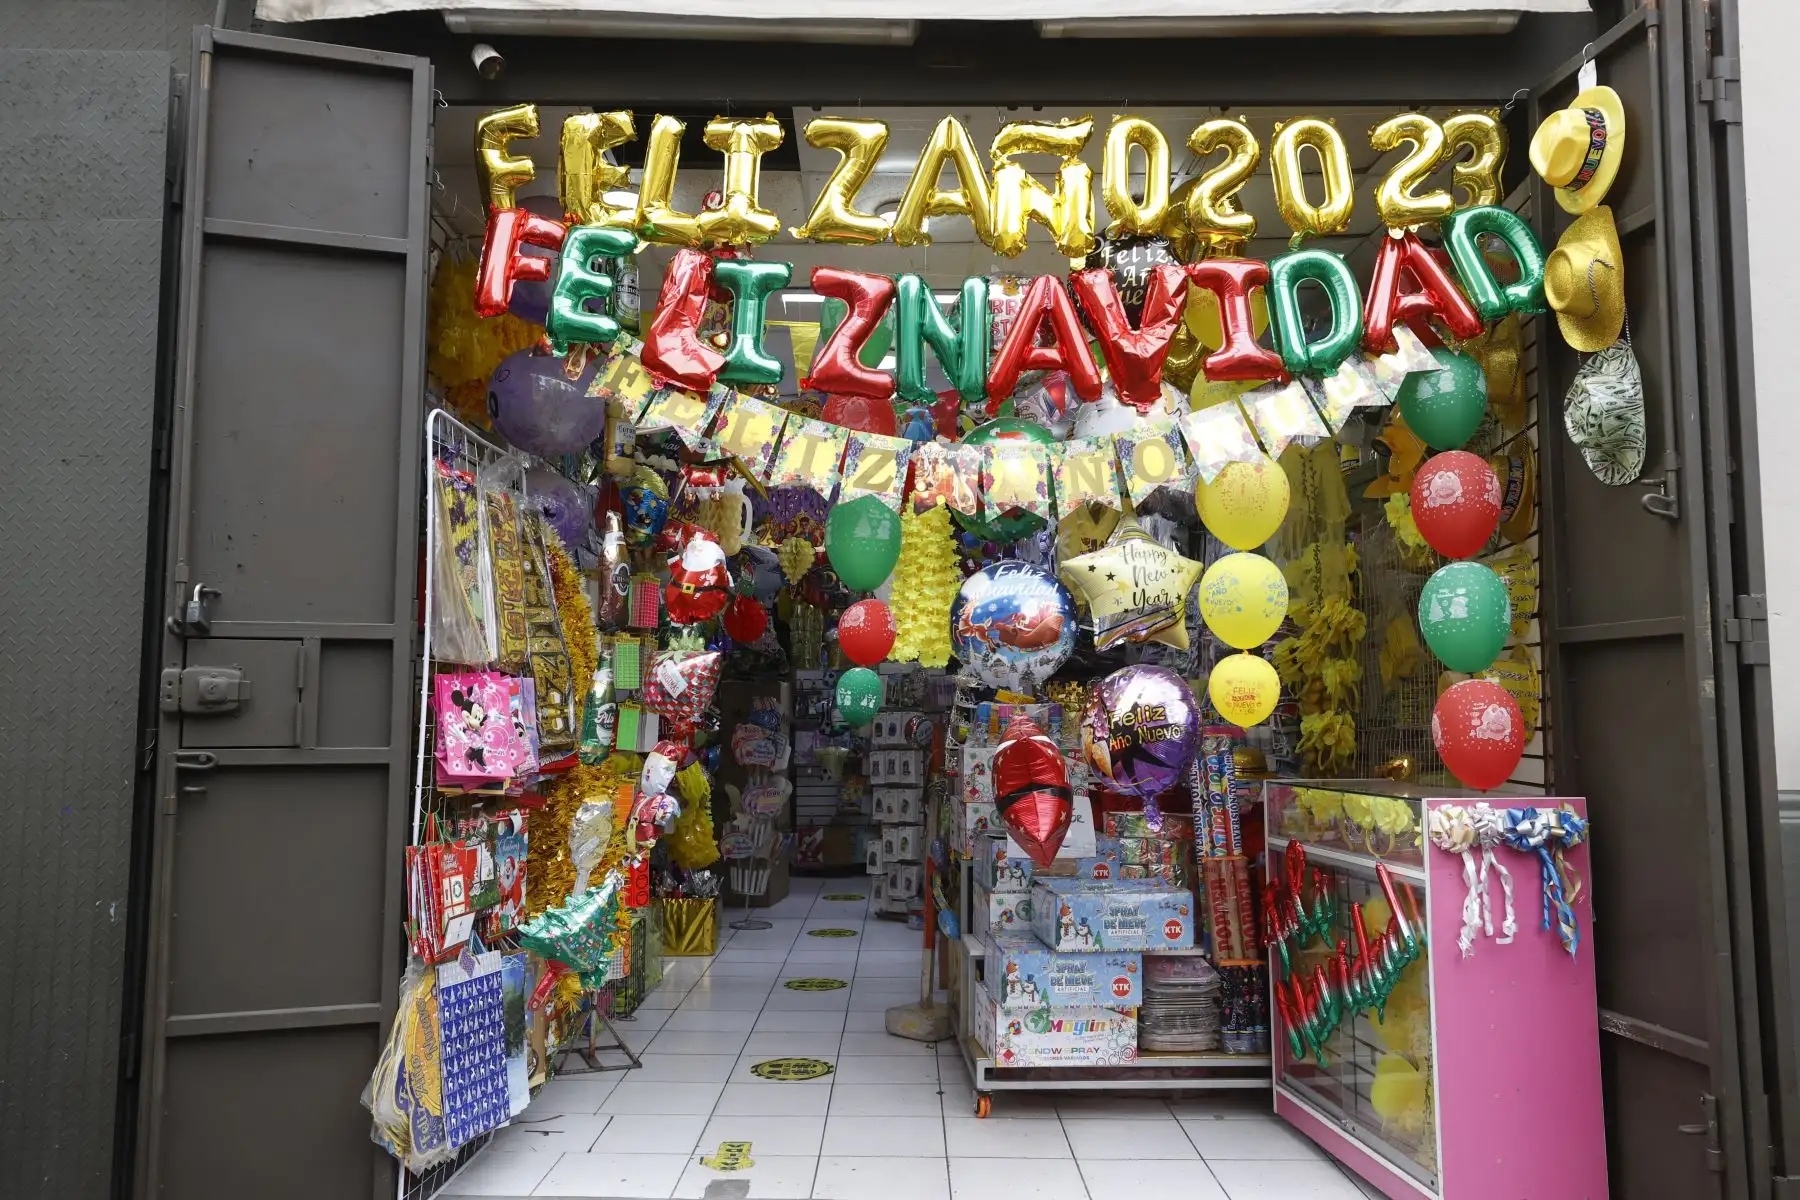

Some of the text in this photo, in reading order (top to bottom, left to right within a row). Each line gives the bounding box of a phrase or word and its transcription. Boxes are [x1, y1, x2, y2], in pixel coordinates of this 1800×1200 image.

[1579, 129, 1606, 181] NUEVO
[1100, 243, 1169, 268] Feliz
[1119, 544, 1167, 566] Happy
[994, 564, 1047, 581] Feliz
[1132, 565, 1168, 588] New
[1132, 588, 1171, 615] Year
[1108, 704, 1166, 730] Feliz
[1109, 724, 1182, 752] Año Nuevo
[1225, 797, 1241, 848] DIVERSIÓN
[1093, 869, 1109, 877] KTK
[1108, 903, 1141, 917] SPRAY
[1212, 878, 1232, 952] POPPER
[1103, 918, 1148, 930] DE NIEVE
[1164, 925, 1182, 935] KTK
[1055, 961, 1087, 974] SPRAY
[1050, 976, 1095, 987] DE NIEVE
[1111, 982, 1131, 991] KTK
